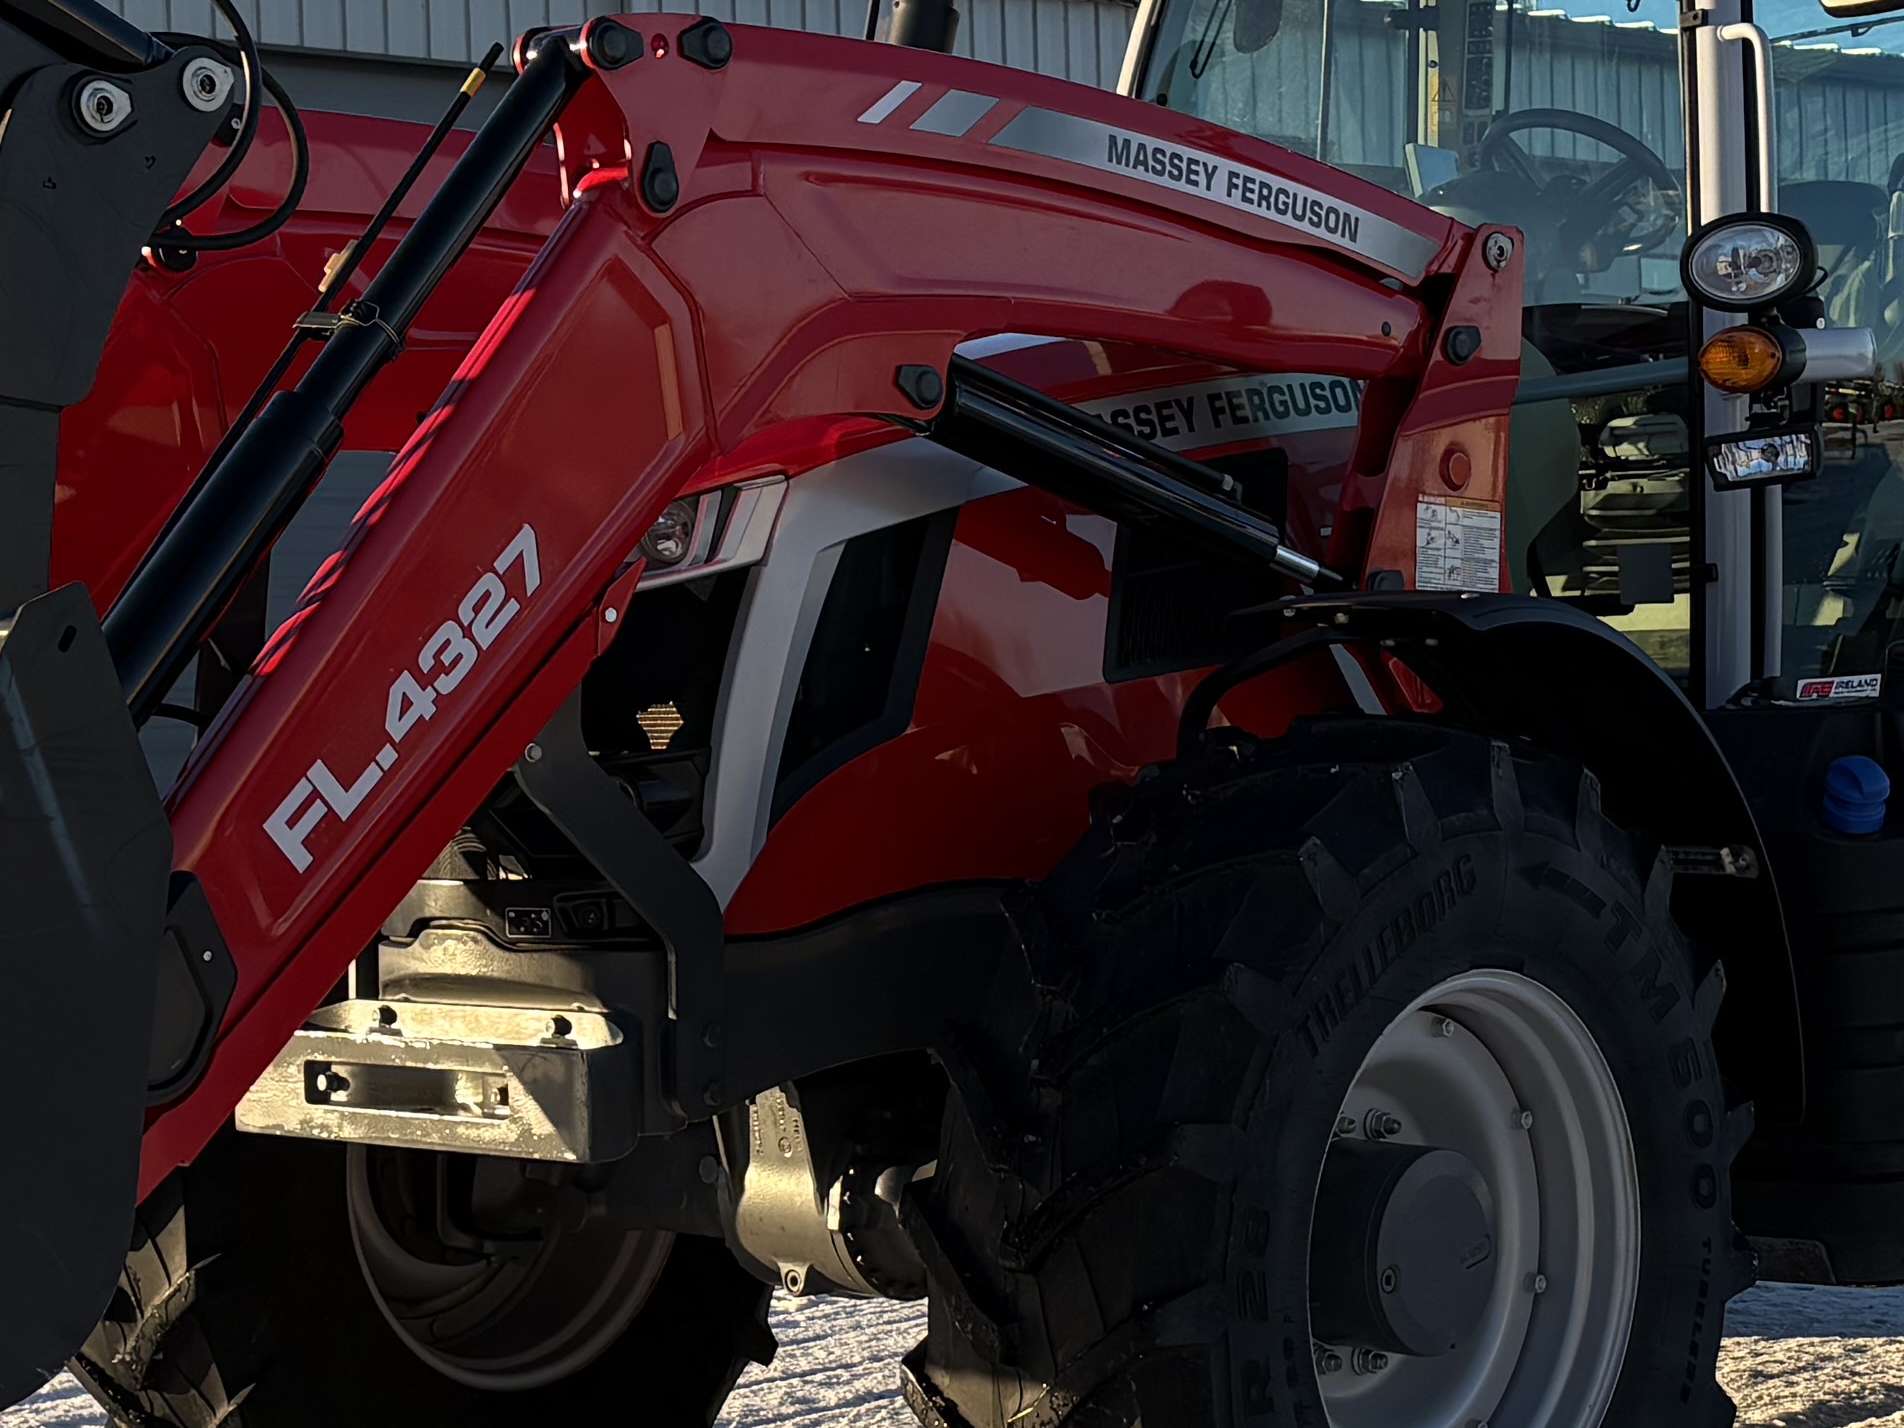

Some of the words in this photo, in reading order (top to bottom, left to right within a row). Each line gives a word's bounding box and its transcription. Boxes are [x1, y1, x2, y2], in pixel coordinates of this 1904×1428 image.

[1107, 134, 1218, 192] MASSEY
[1226, 170, 1360, 244] FERGUSON
[262, 523, 541, 874] FL.4327
[1835, 678, 1879, 690] IRELAND
[1297, 852, 1477, 1060] TRELLEBORG
[1603, 899, 1681, 1025] TM
[1667, 1036, 1719, 1212] 600
